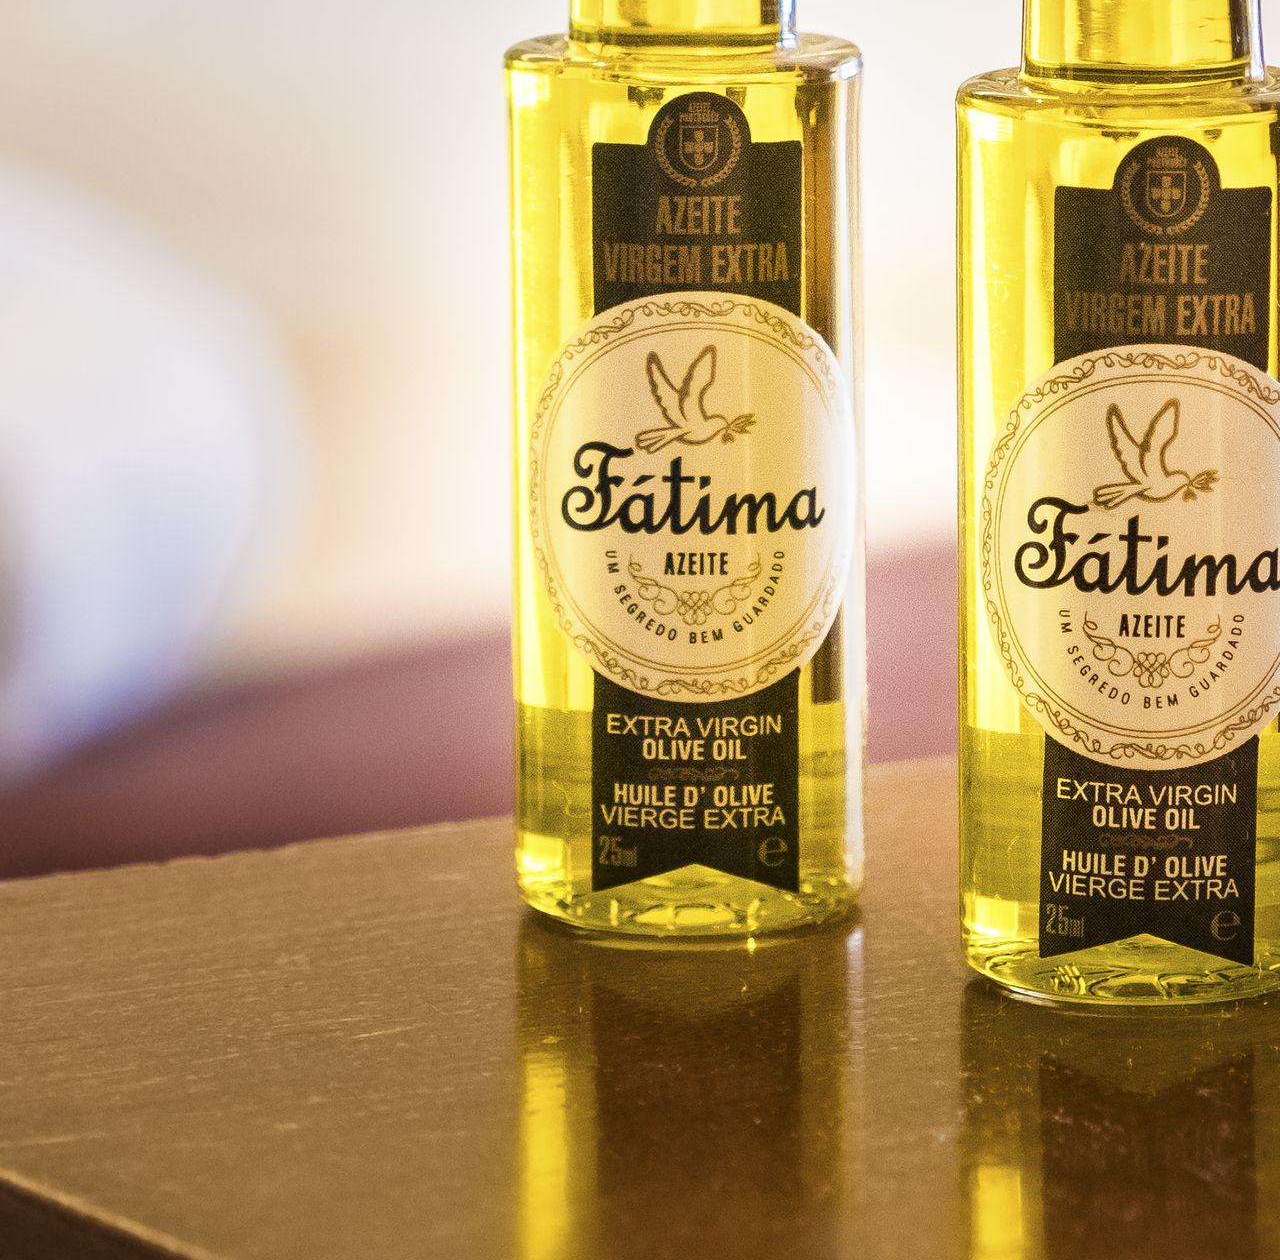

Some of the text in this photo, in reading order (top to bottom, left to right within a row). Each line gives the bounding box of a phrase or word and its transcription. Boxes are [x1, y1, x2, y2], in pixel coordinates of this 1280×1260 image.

[655, 195, 742, 236] AZEITE
[602, 242, 790, 284] VIRGEM EXTRA
[1120, 243, 1210, 286] AZEITE
[1067, 290, 1257, 336] VIRGEM EXTRA
[561, 441, 826, 536] Fátima
[663, 551, 729, 576] AZEITE
[604, 549, 785, 645] UM SEGREDO BEM GUARDADO
[1119, 613, 1187, 639] AZEITE
[1058, 608, 1246, 710] UM SEGREDO BEM GUARDADO
[606, 713, 782, 738] EXTRA VIRGIN
[642, 738, 747, 761] OLIVE OIL
[613, 782, 774, 808] HUILE D' OLIVE
[1056, 777, 1238, 806] EXTRA VIRGIN
[600, 804, 786, 830] VIERGE EXTRA
[1092, 805, 1201, 831] OLIVE OIL
[1062, 849, 1228, 878] HUILE D' OLIVE
[1048, 870, 1239, 902] VIERGE EXTRA
